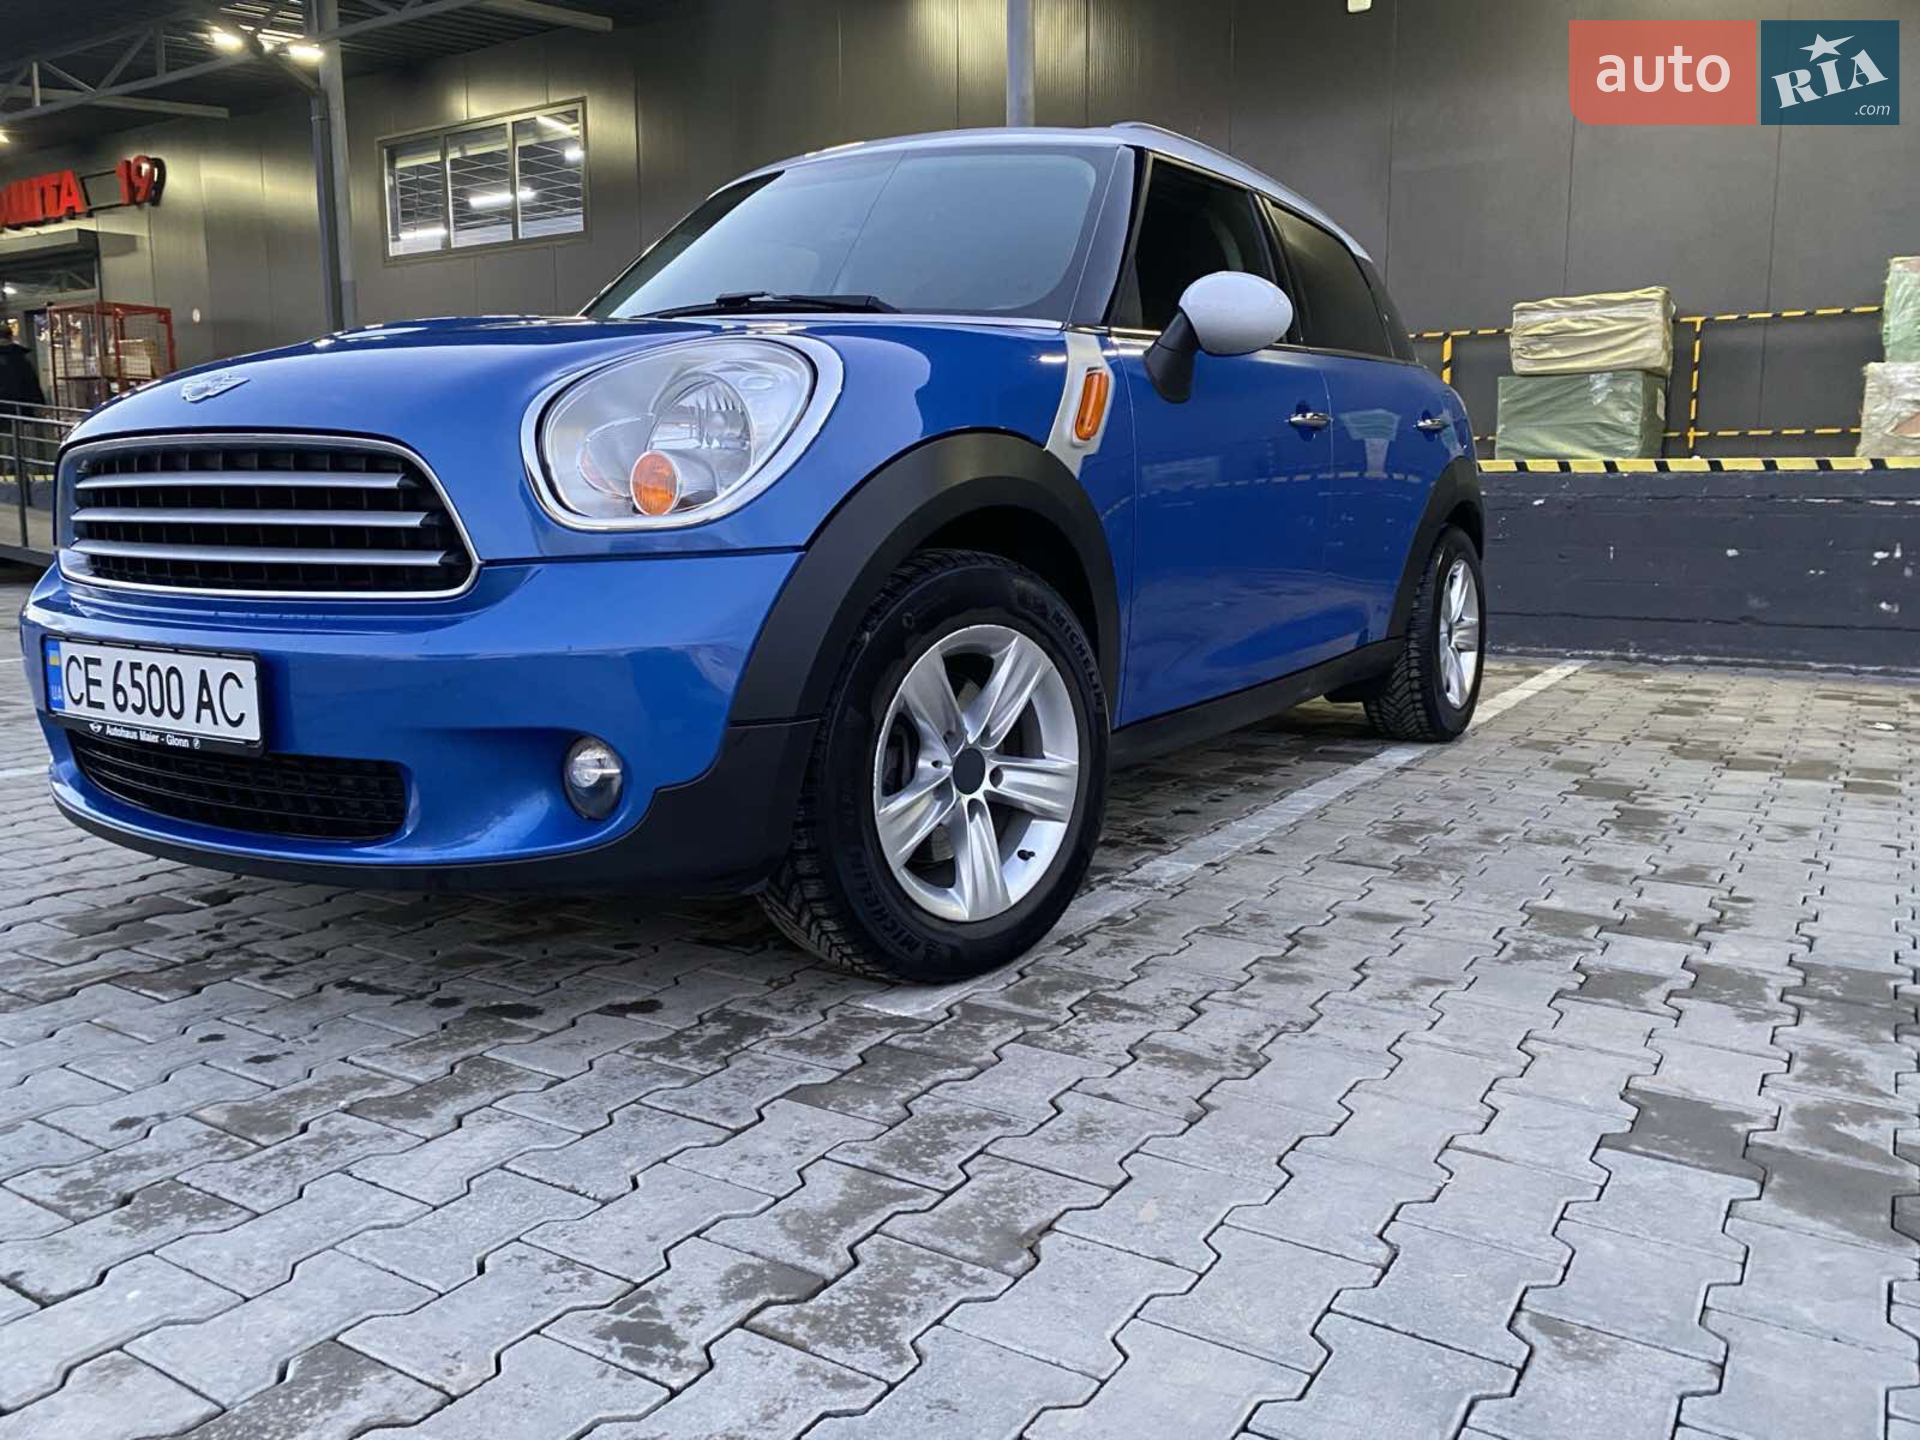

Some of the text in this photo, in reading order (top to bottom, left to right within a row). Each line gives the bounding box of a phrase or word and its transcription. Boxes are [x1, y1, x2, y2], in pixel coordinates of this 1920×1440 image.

[65, 655, 246, 728] CE 6500 AC
[166, 734, 190, 748] Glonn
